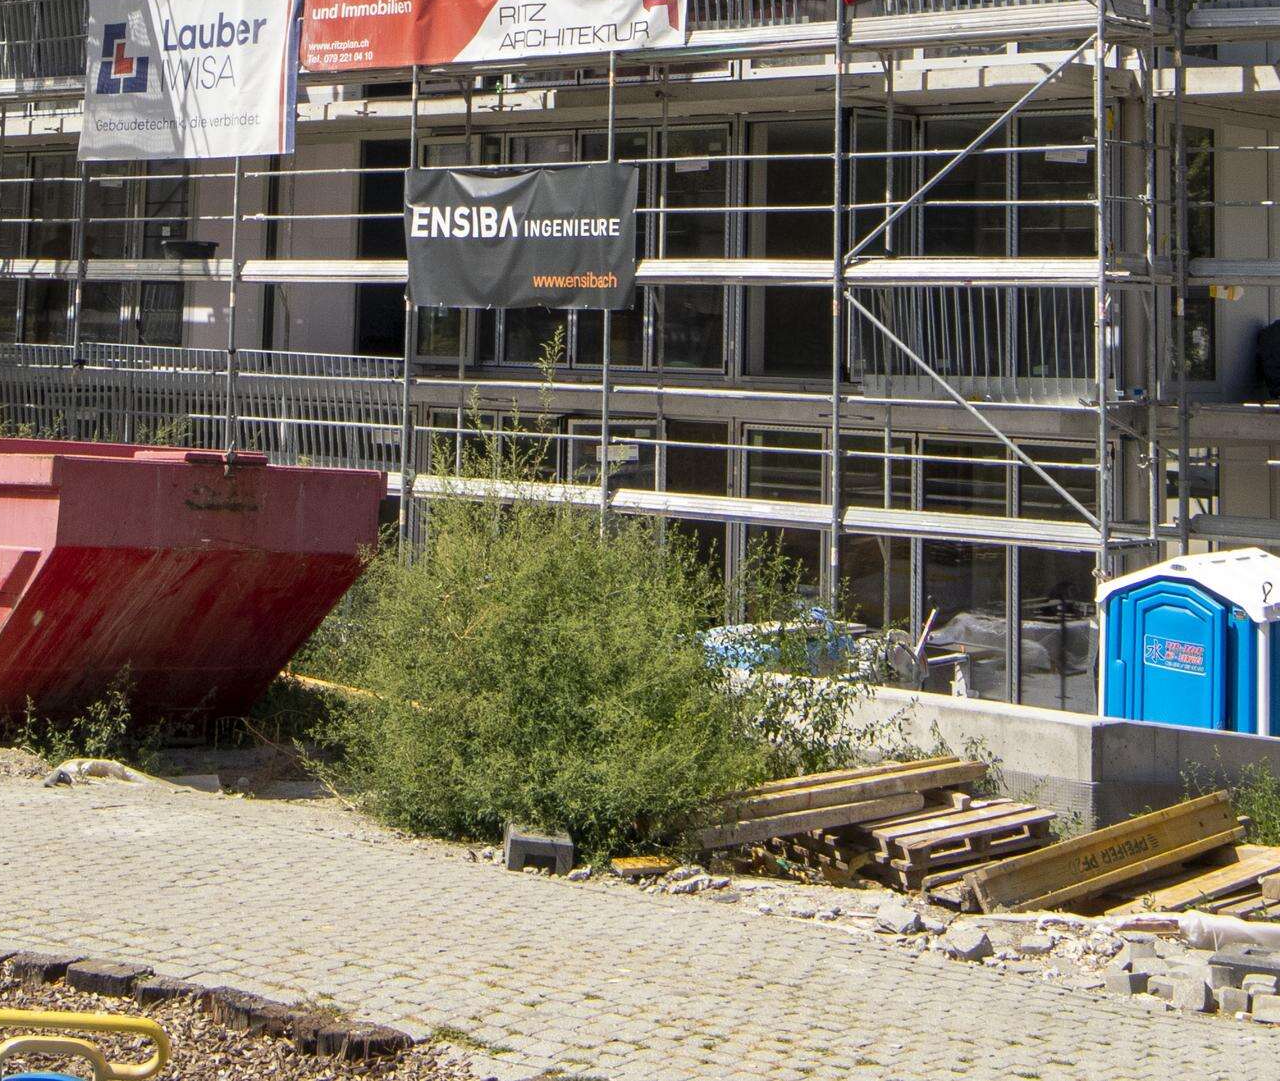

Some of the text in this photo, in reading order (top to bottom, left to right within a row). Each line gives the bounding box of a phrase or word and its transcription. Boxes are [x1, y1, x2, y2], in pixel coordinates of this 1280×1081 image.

[312, 4, 338, 20] und
[499, 3, 547, 26] RITZ
[163, 12, 267, 51] Lauber
[499, 21, 650, 51] ARCHITEKTUR
[308, 39, 369, 52] www.ritzplan.ch
[323, 54, 338, 63] 079
[338, 53, 353, 62] 221
[354, 52, 363, 61] 04
[364, 51, 373, 61] 10
[161, 55, 235, 92] IWISA
[190, 116, 207, 128] die
[411, 206, 620, 238] ENSIBA INGENIEURE
[533, 271, 617, 288] www.ensibach
